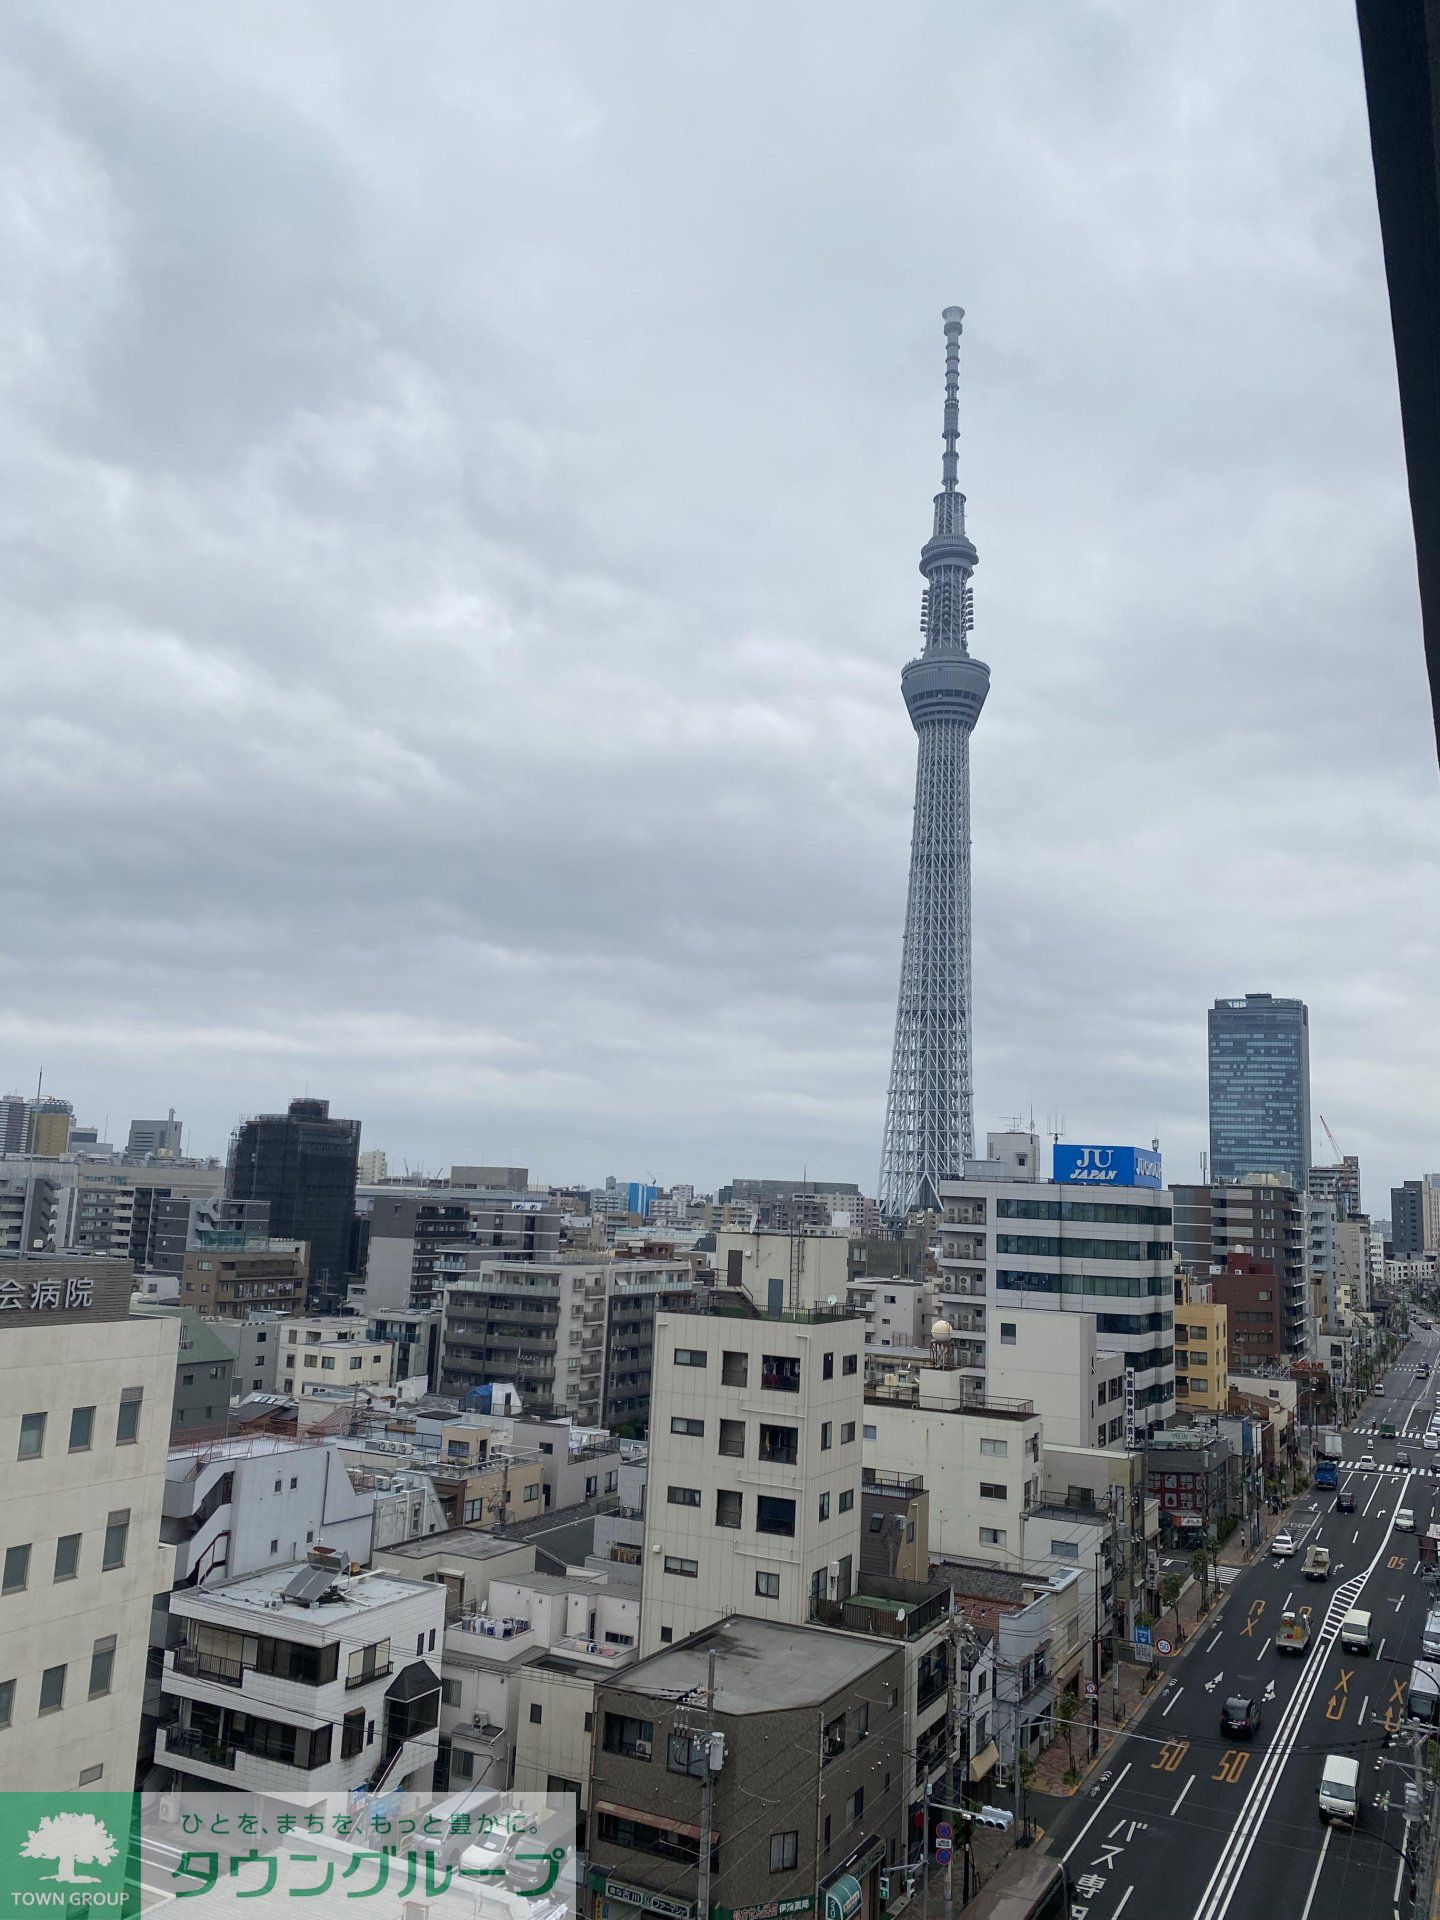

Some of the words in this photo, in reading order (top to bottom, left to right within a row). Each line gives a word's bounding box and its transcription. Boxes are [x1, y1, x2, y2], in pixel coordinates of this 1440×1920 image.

[1076, 1148, 1114, 1168] JU
[1069, 1168, 1118, 1180] JAPAN
[0, 1277, 94, 1310] 会病院
[1159, 1642, 1169, 1651] 50
[1150, 1740, 1191, 1772] 50
[1211, 1750, 1250, 1783] 50
